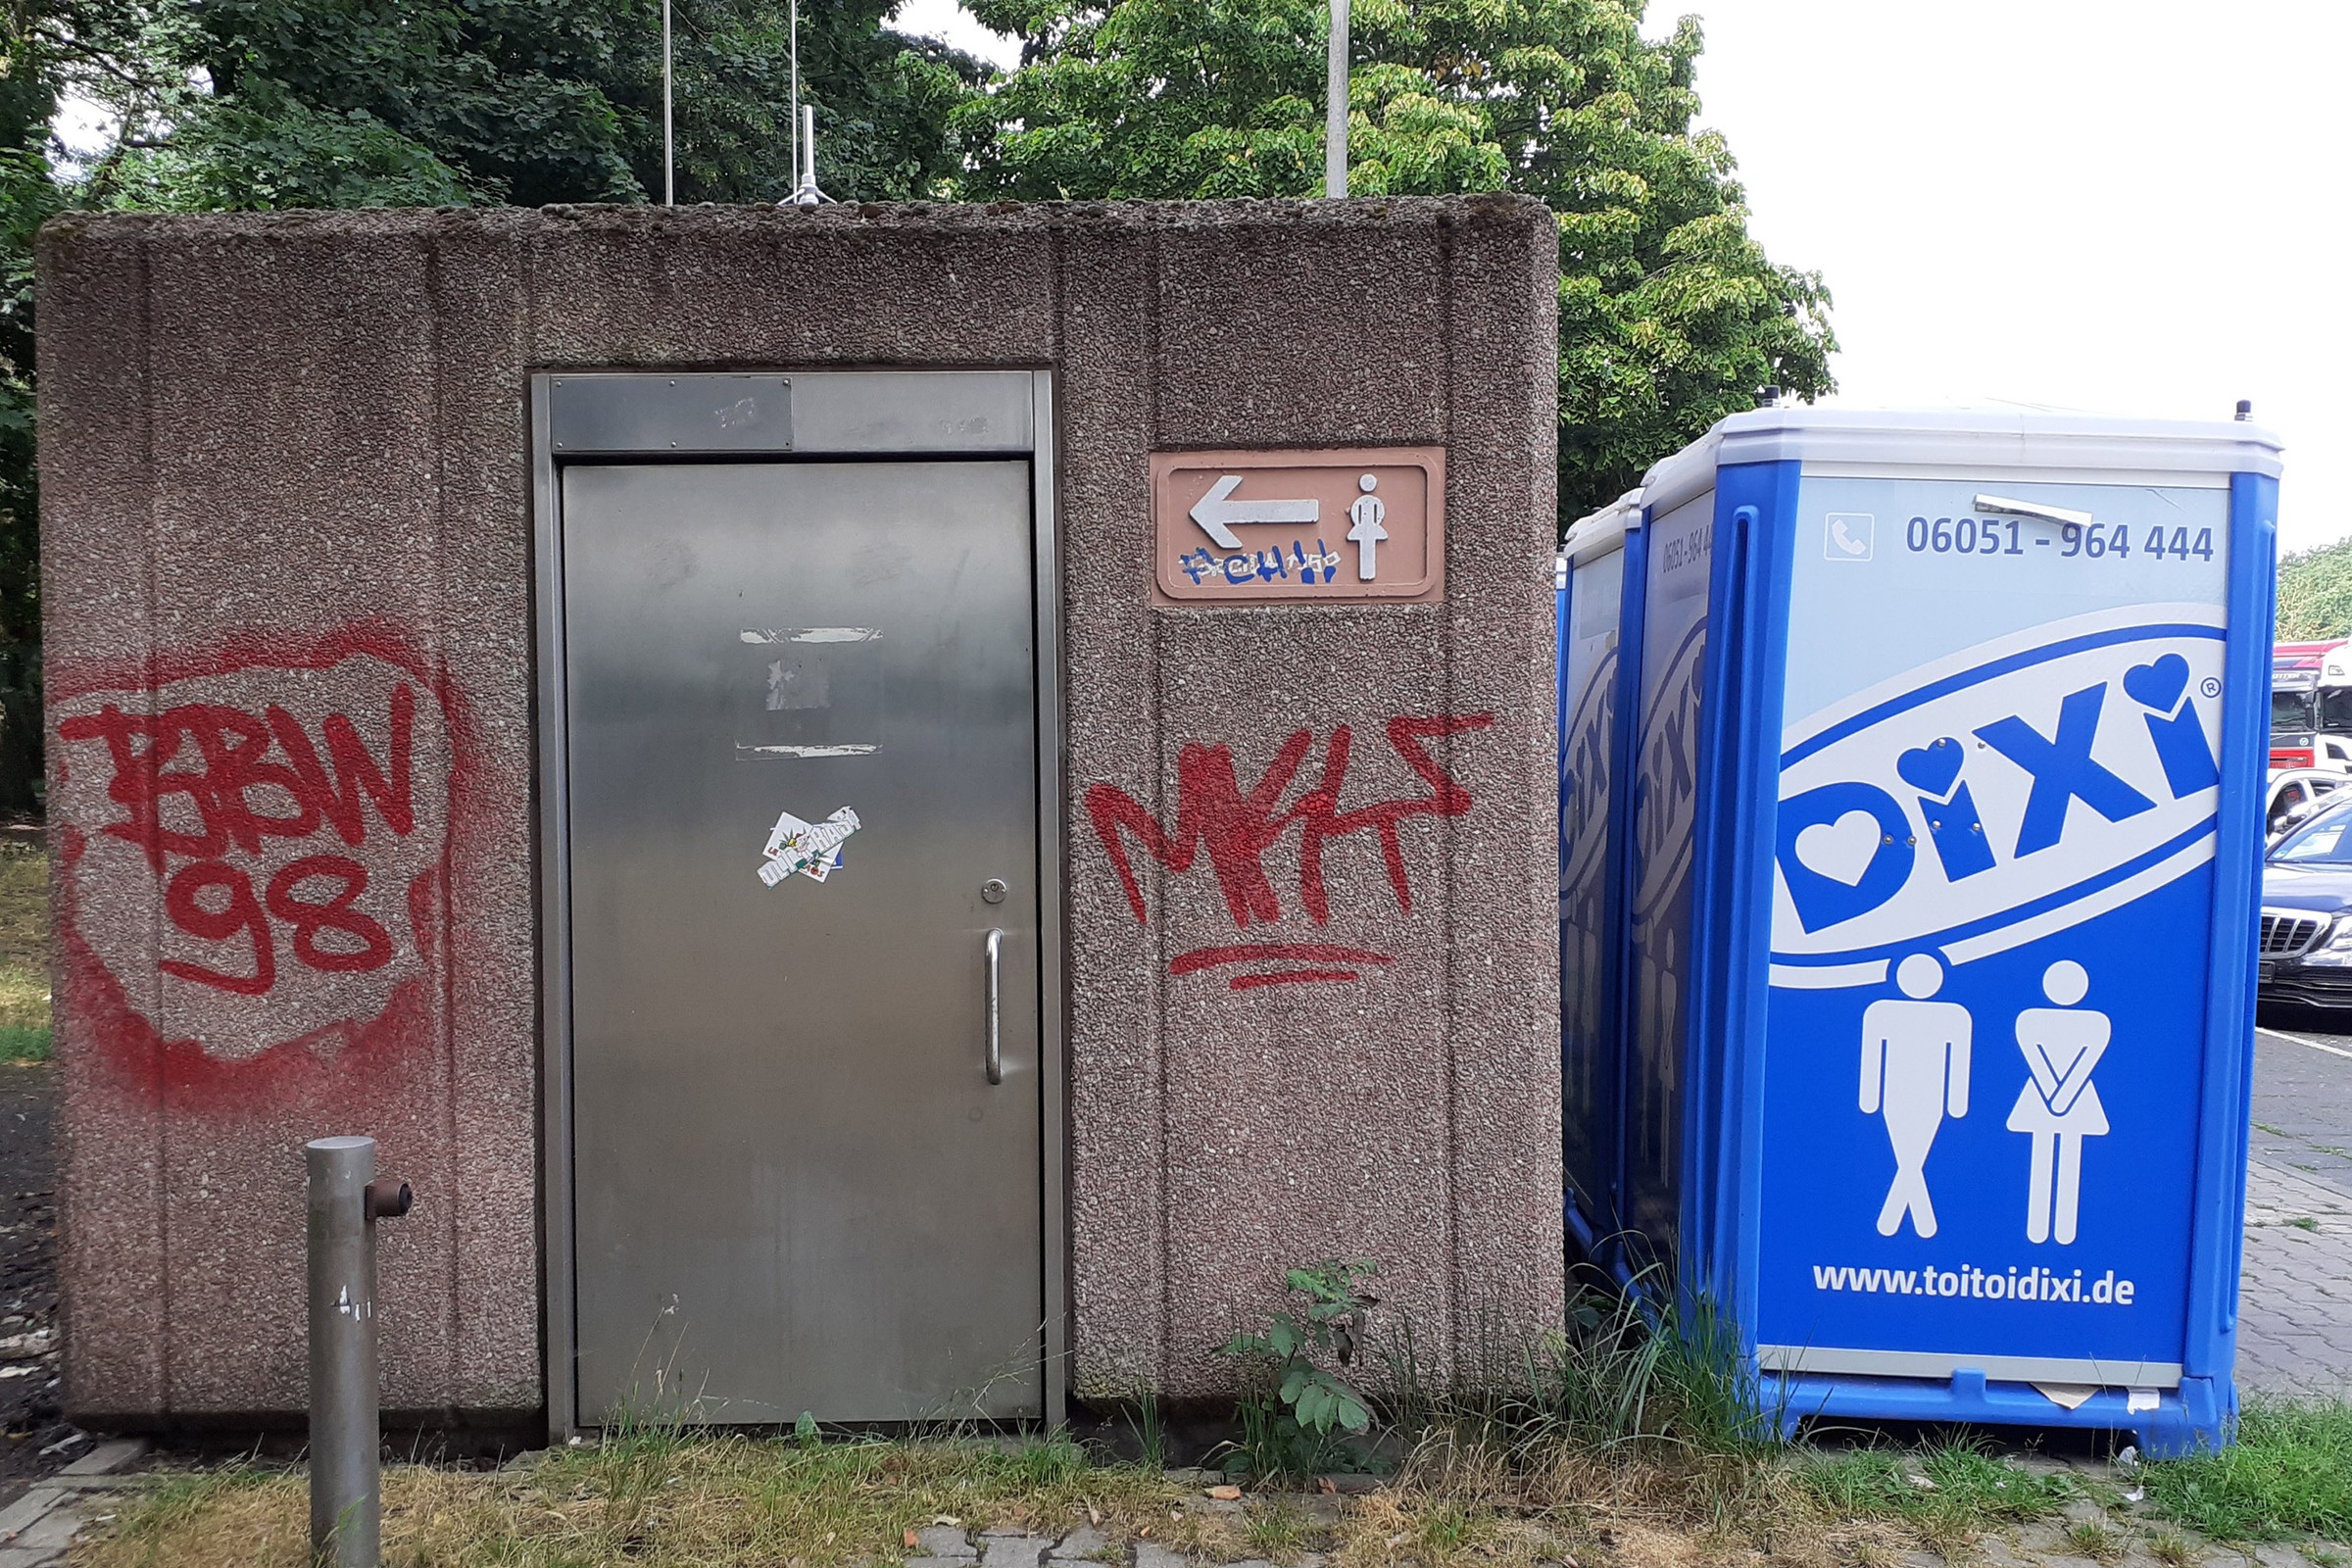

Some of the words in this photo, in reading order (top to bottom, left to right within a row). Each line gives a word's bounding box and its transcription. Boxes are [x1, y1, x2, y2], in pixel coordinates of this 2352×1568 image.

[1907, 516, 2025, 556] 06051
[2061, 521, 2131, 559] 964
[2144, 524, 2214, 562] 444
[158, 854, 394, 996] 98
[1812, 1263, 2135, 1305] www.toitoidixi.de
